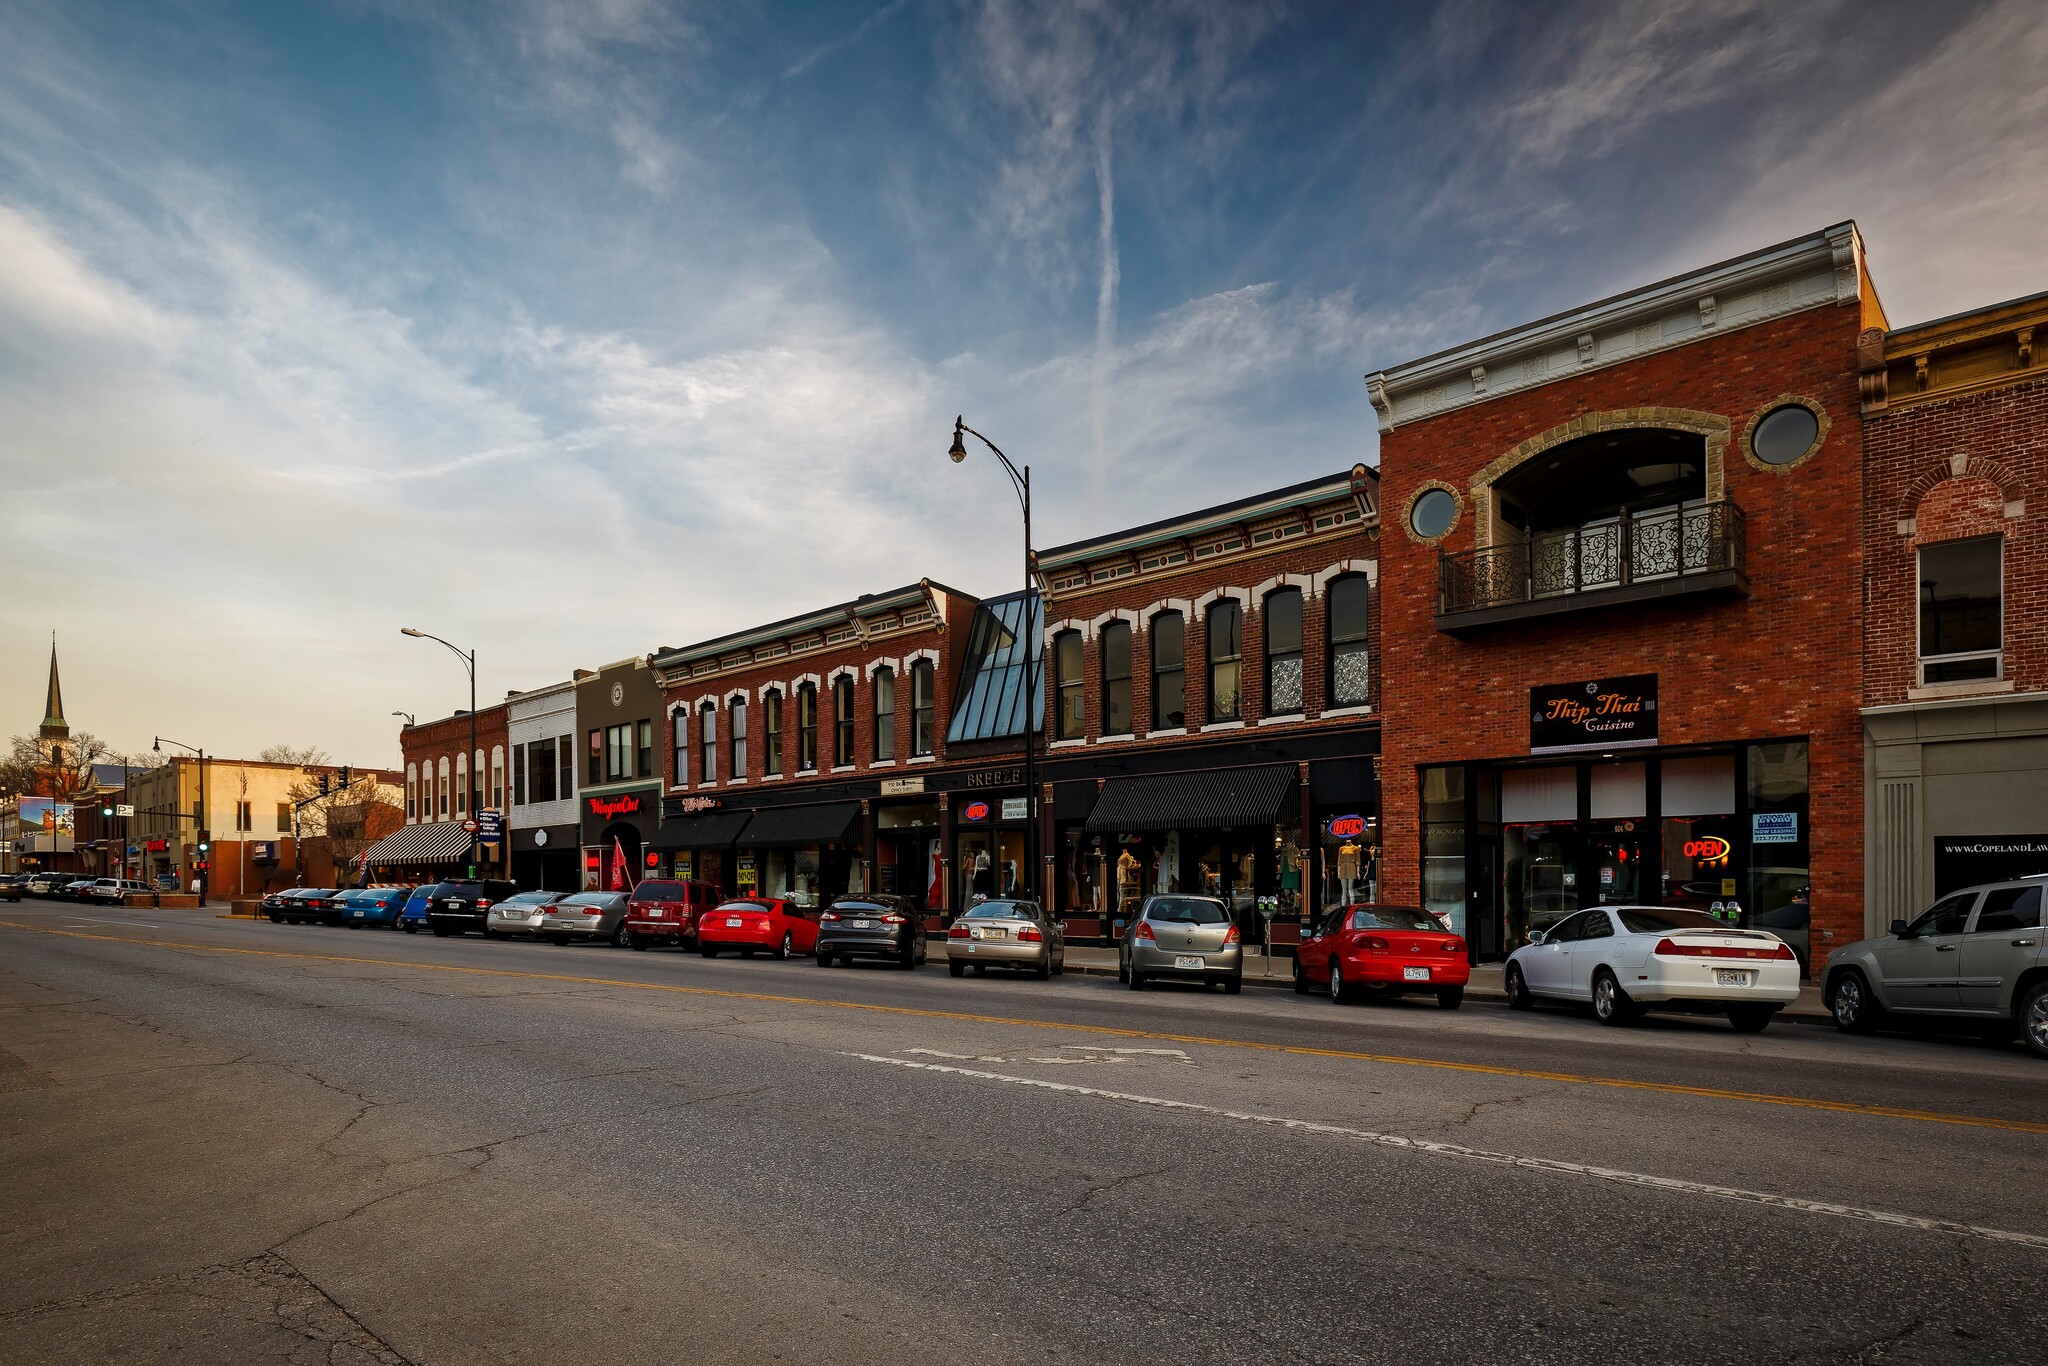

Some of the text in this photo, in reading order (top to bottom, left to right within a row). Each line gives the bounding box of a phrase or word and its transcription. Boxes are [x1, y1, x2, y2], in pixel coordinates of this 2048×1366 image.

[1546, 693, 1642, 724] Thip Thai
[1582, 718, 1635, 732] Cuisine
[967, 769, 1020, 787] BREEZE
[1332, 818, 1364, 835] OPEN
[1169, 839, 1177, 872] SALE
[1683, 841, 1722, 857] OPEN
